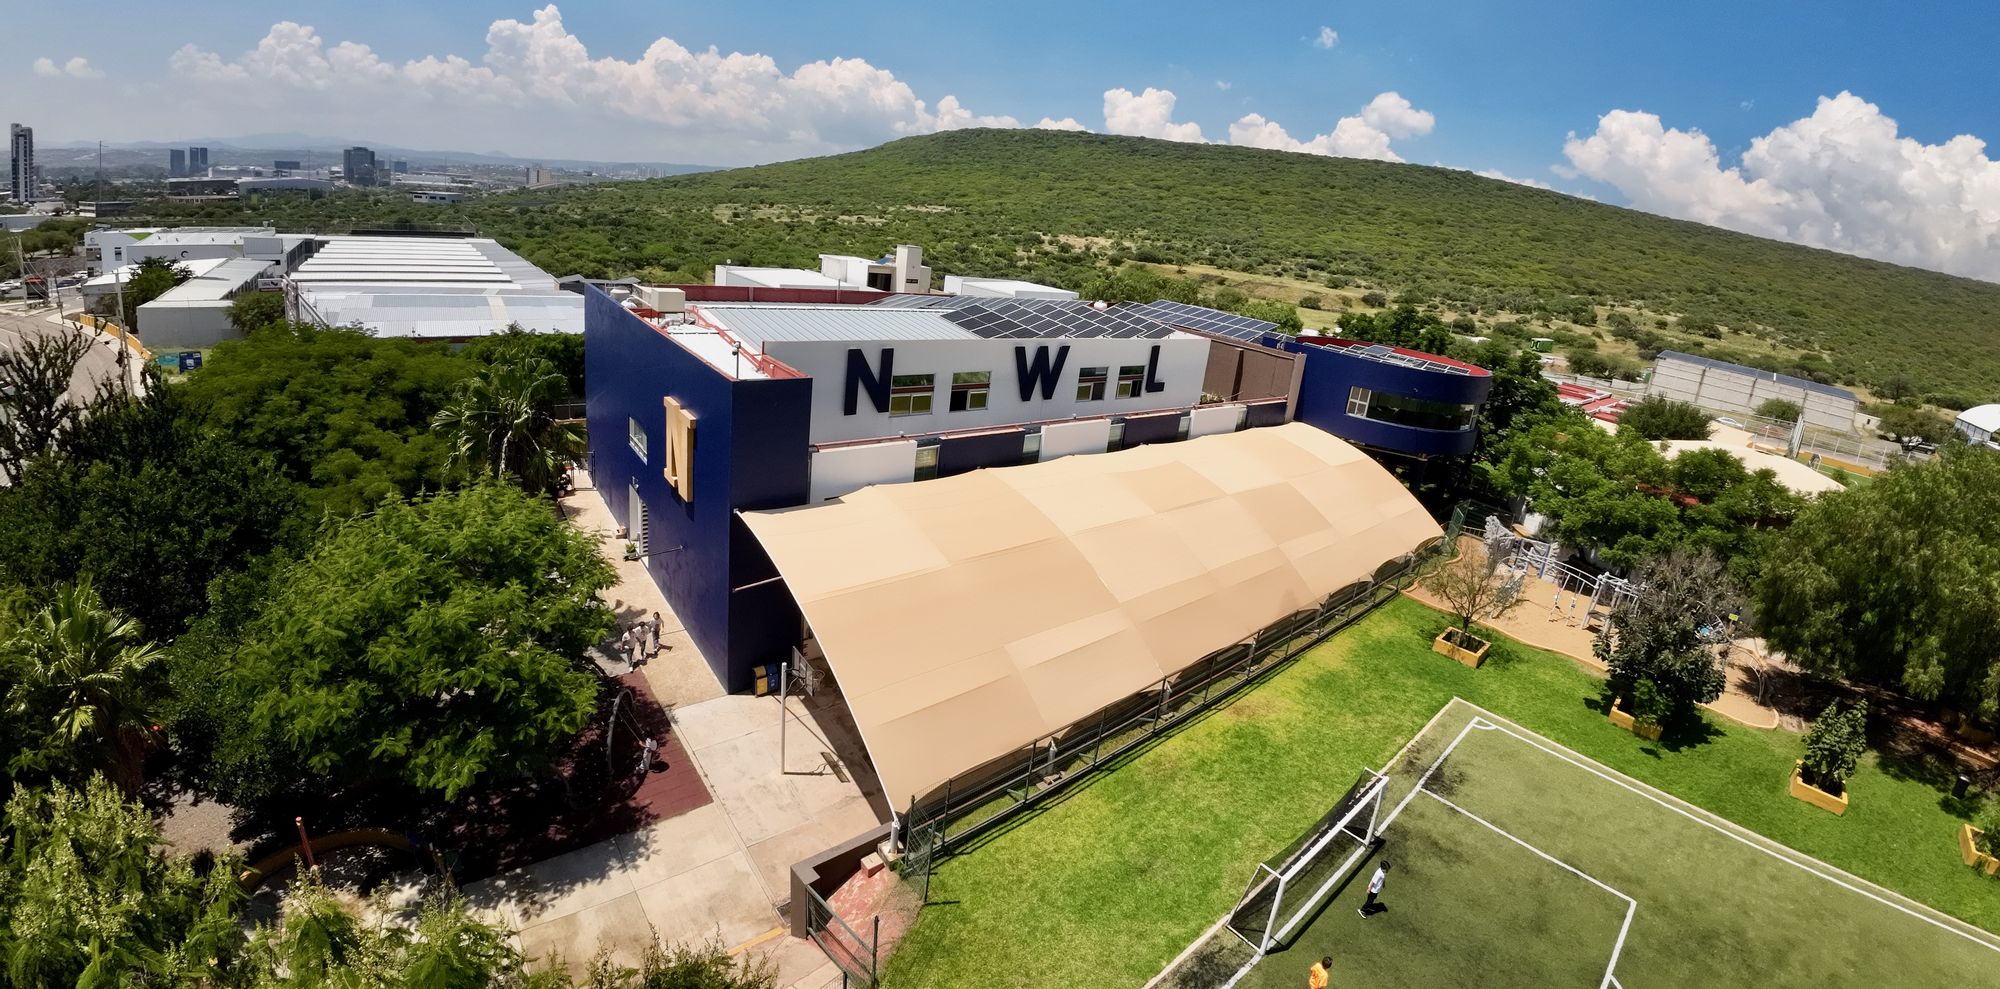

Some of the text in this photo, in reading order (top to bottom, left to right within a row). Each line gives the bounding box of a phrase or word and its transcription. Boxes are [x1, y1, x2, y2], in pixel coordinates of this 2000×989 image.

[843, 344, 1165, 416] N W L
[663, 396, 697, 503] N
